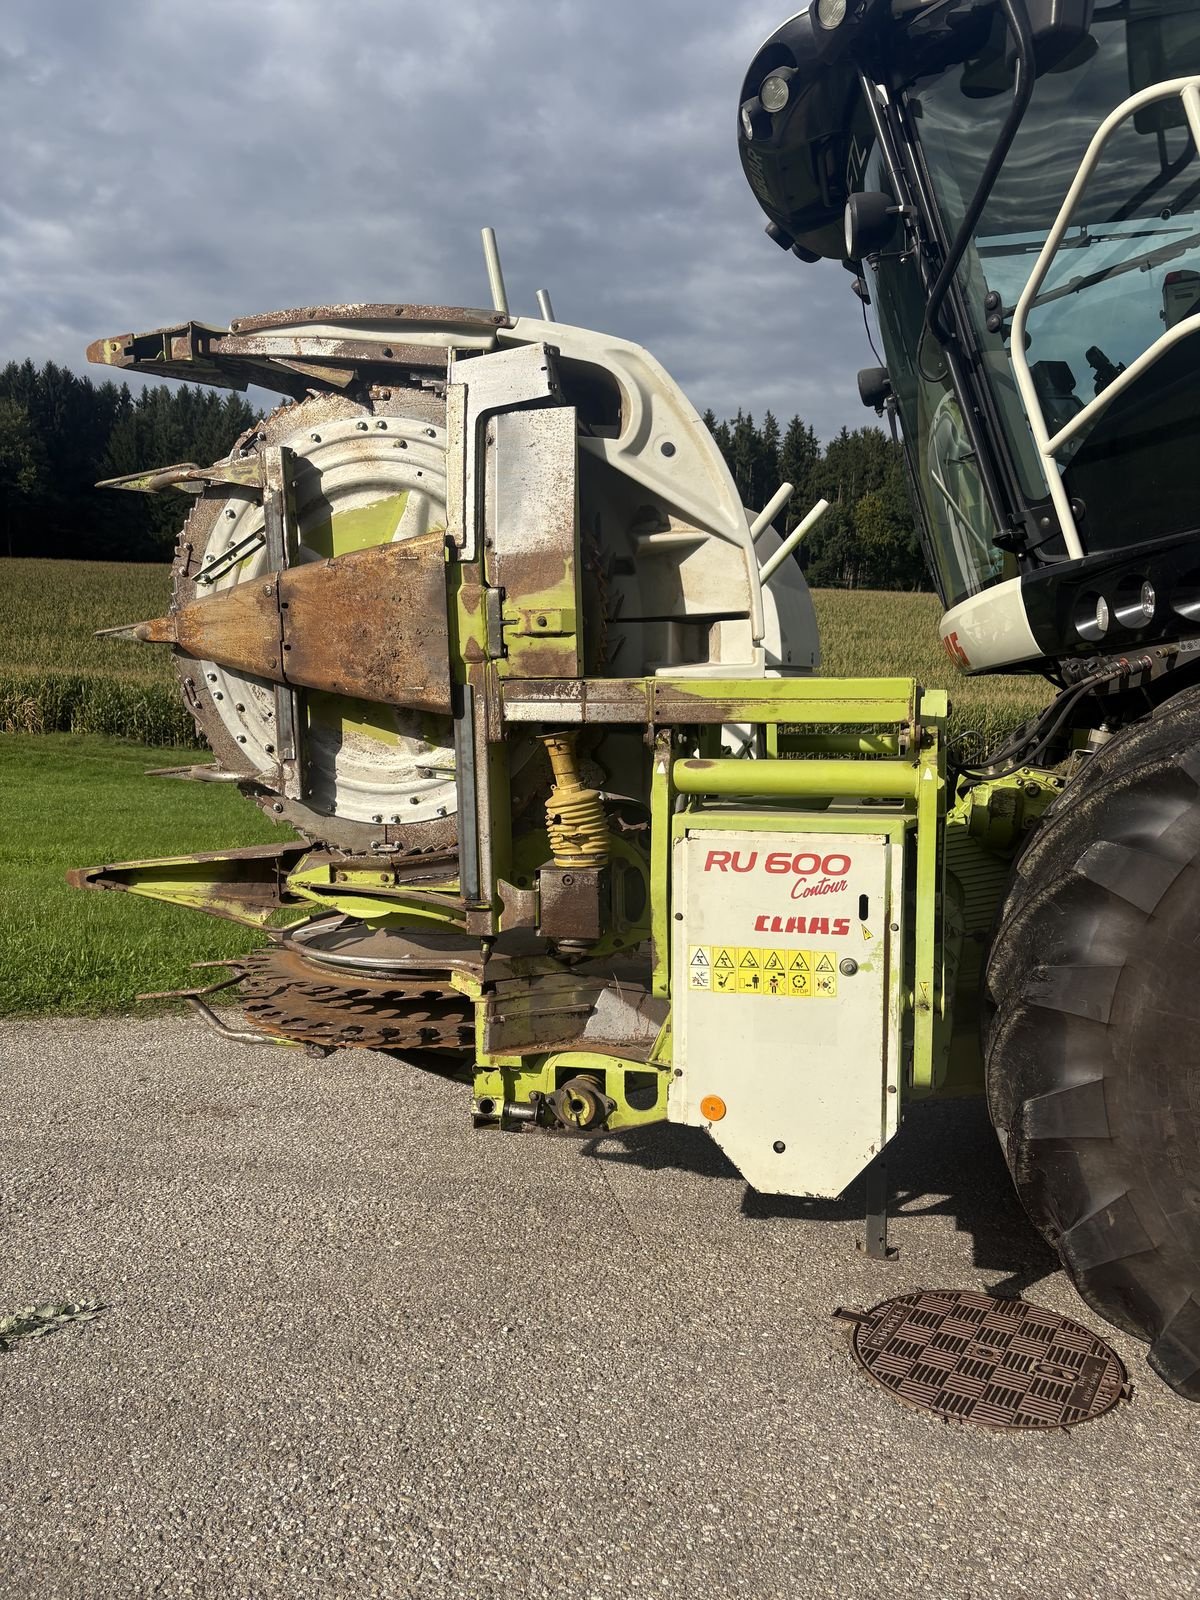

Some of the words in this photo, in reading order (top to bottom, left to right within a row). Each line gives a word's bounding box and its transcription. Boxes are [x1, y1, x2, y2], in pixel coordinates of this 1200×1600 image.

[704, 850, 758, 873] RU
[764, 853, 852, 876] 600
[790, 877, 848, 899] Contour
[754, 915, 850, 935] CLAAS
